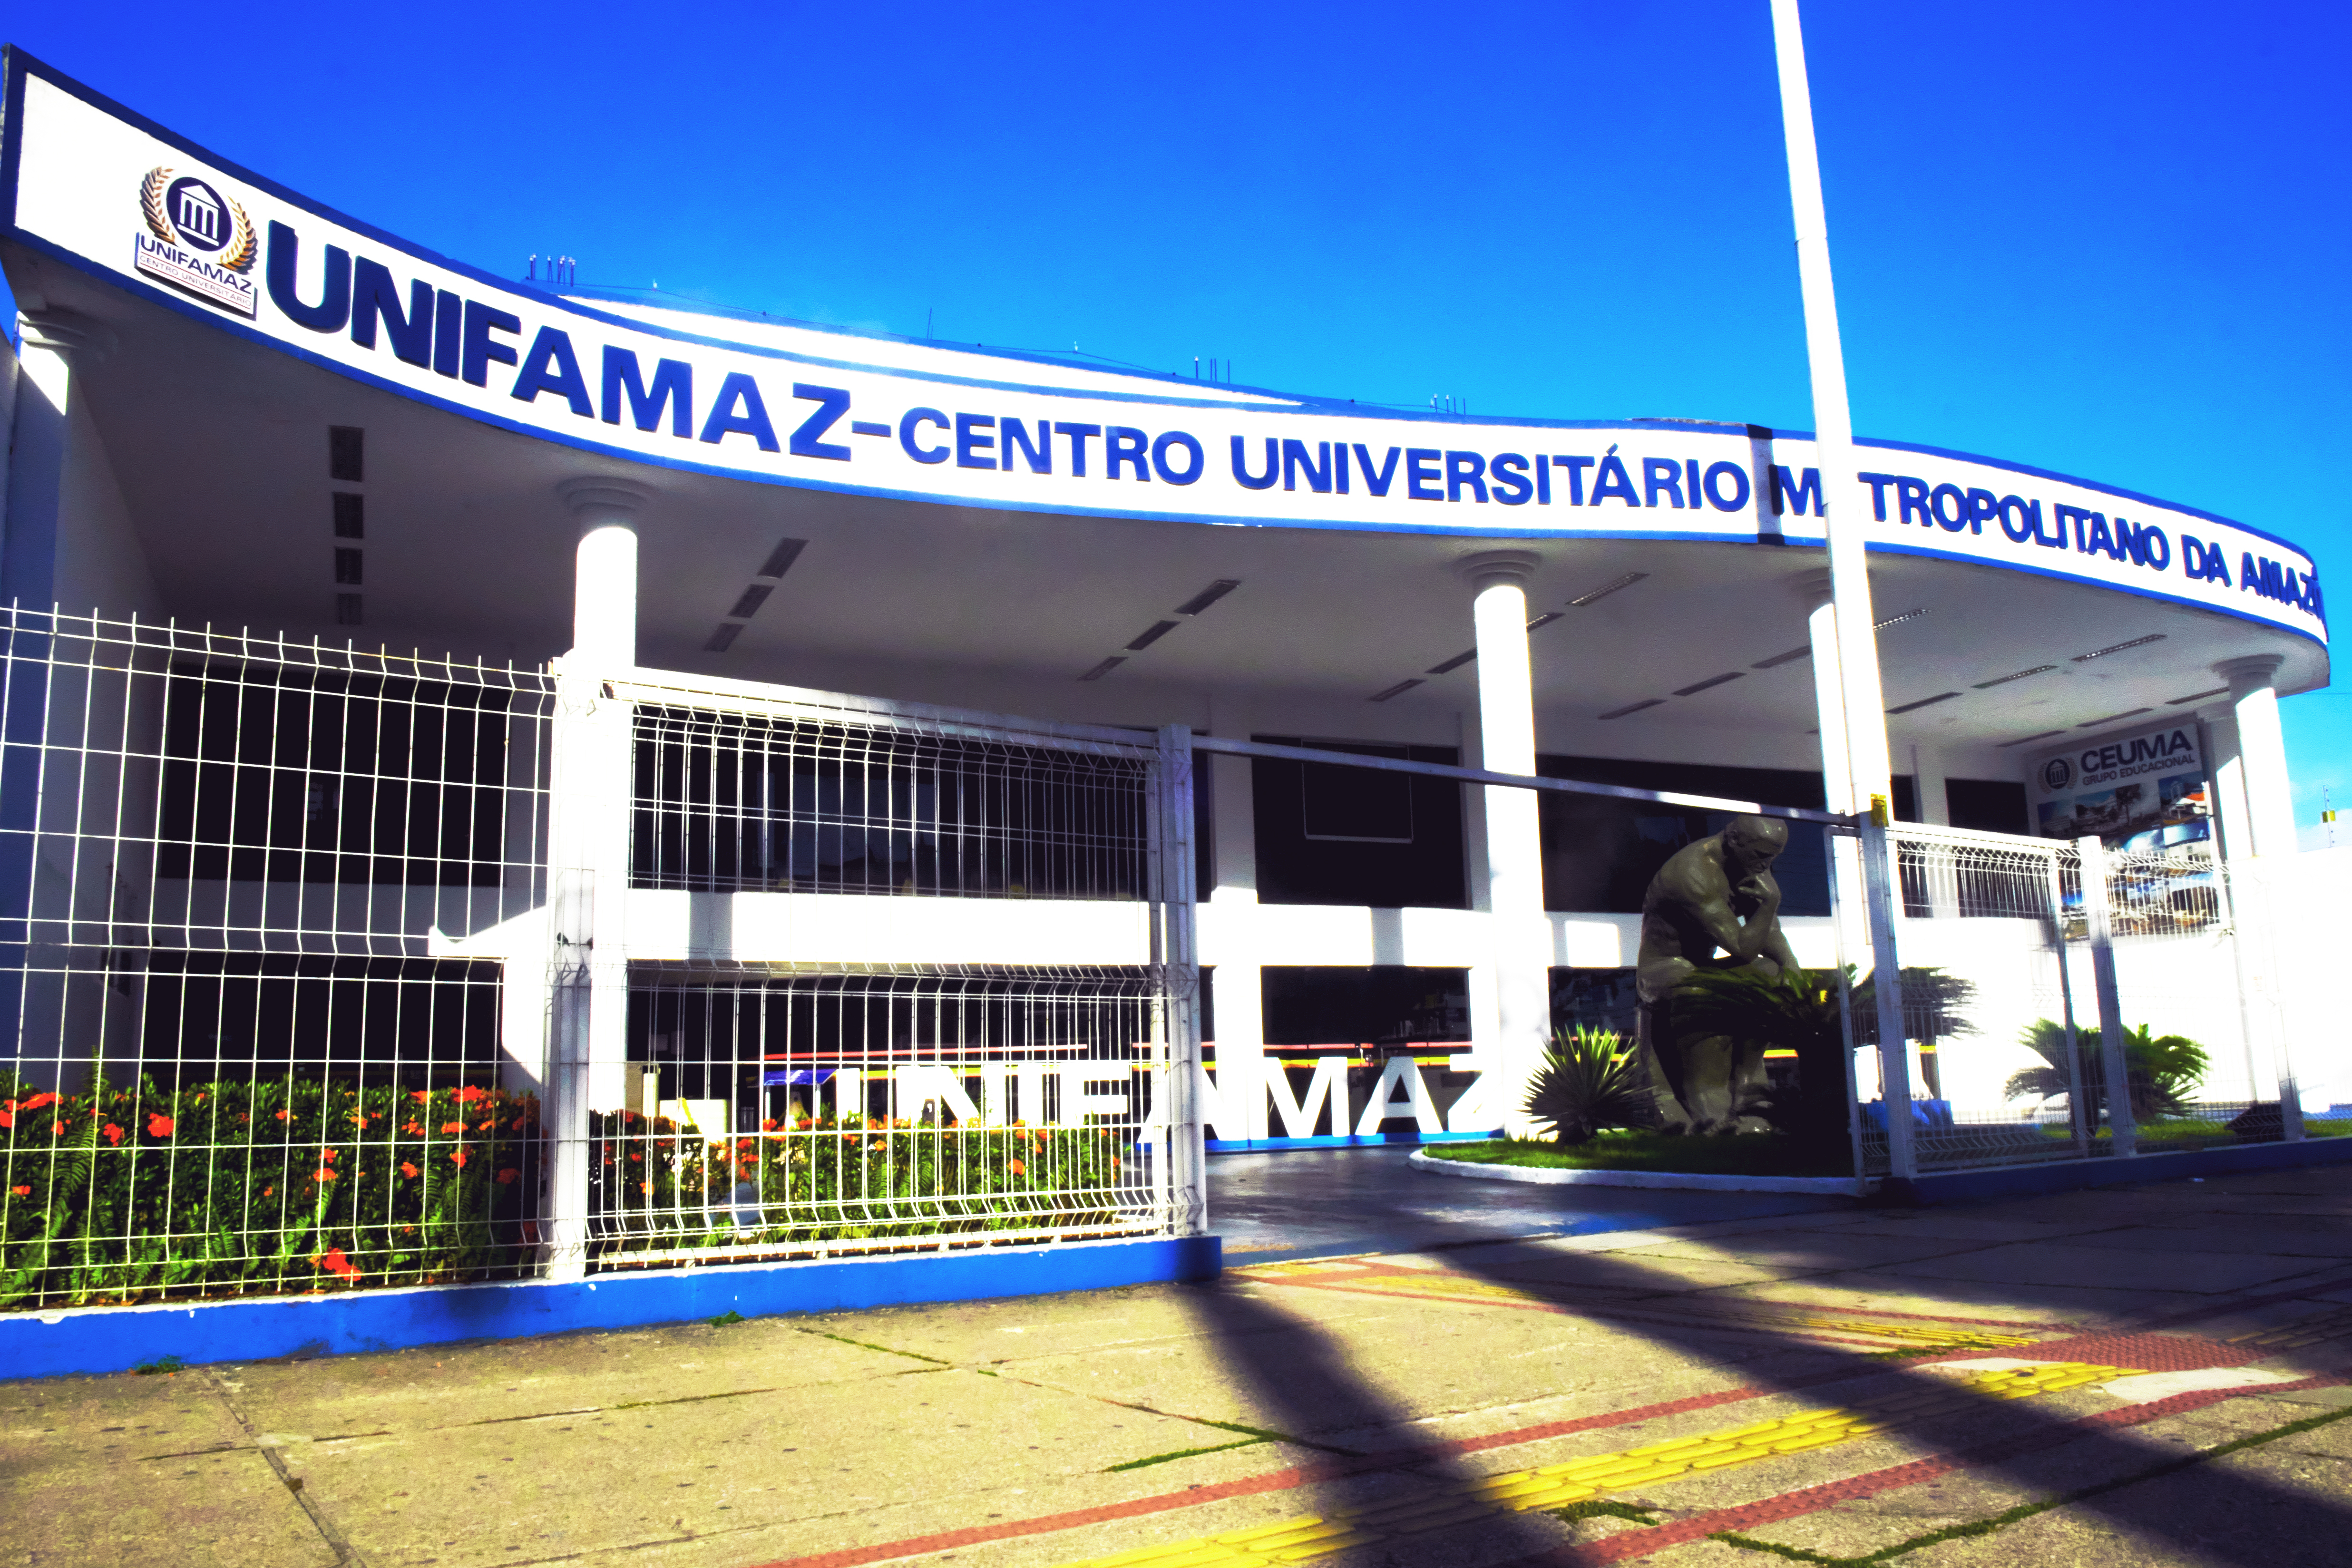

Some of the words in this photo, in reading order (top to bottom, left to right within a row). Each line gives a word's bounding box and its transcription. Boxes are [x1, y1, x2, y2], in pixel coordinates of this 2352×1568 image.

[140, 255, 178, 275] CENTRO
[141, 235, 252, 294] UNIFAMAZ
[1230, 435, 1750, 513] UNIVERSITÁRIO
[1768, 464, 2170, 571] MTROPOLITANO
[2181, 535, 2233, 588] DA
[2080, 730, 2193, 773] CEUMA
[2082, 770, 2117, 785] GRUPO
[2119, 754, 2195, 778] EDUCACIONAL
